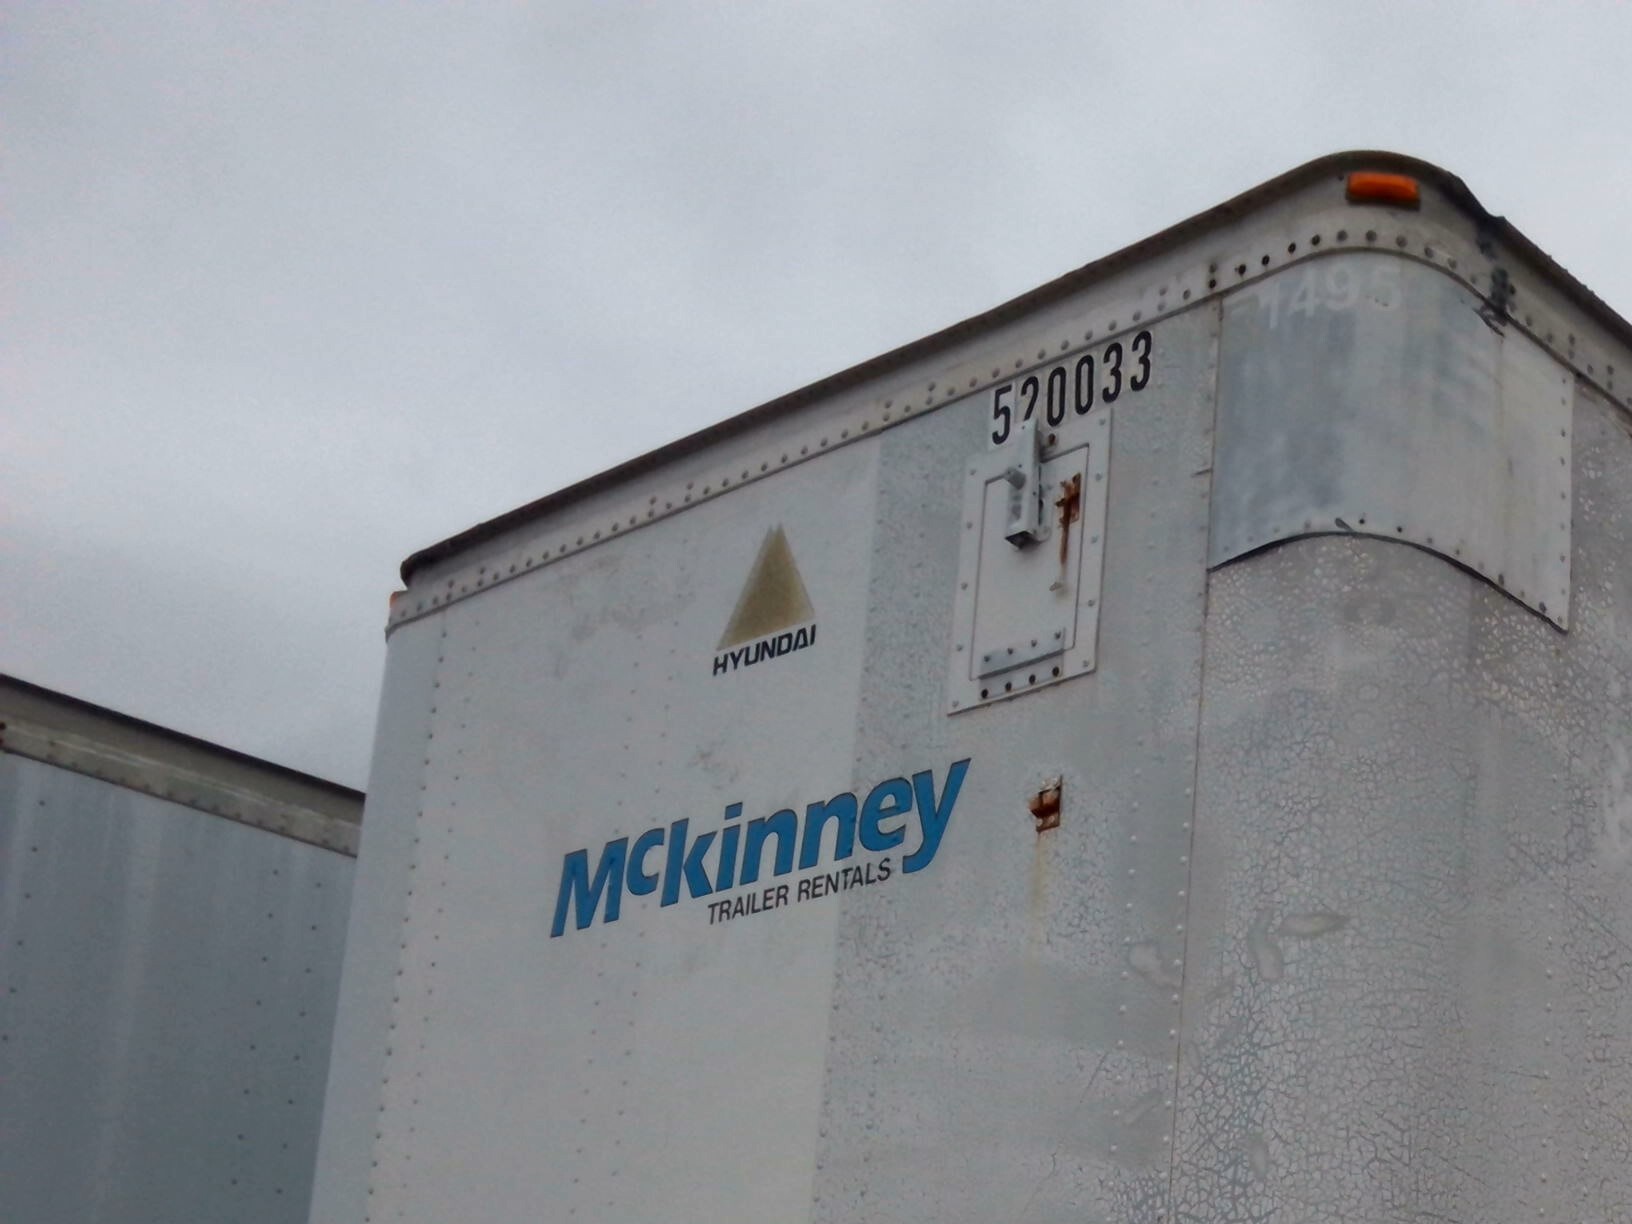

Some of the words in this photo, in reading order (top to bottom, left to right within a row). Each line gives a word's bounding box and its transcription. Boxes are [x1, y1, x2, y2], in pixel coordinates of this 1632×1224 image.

[992, 330, 1153, 445] 520033
[712, 623, 817, 677] HYUNDAI
[708, 886, 790, 925] TRAILER
[797, 857, 893, 904] RENTALS
